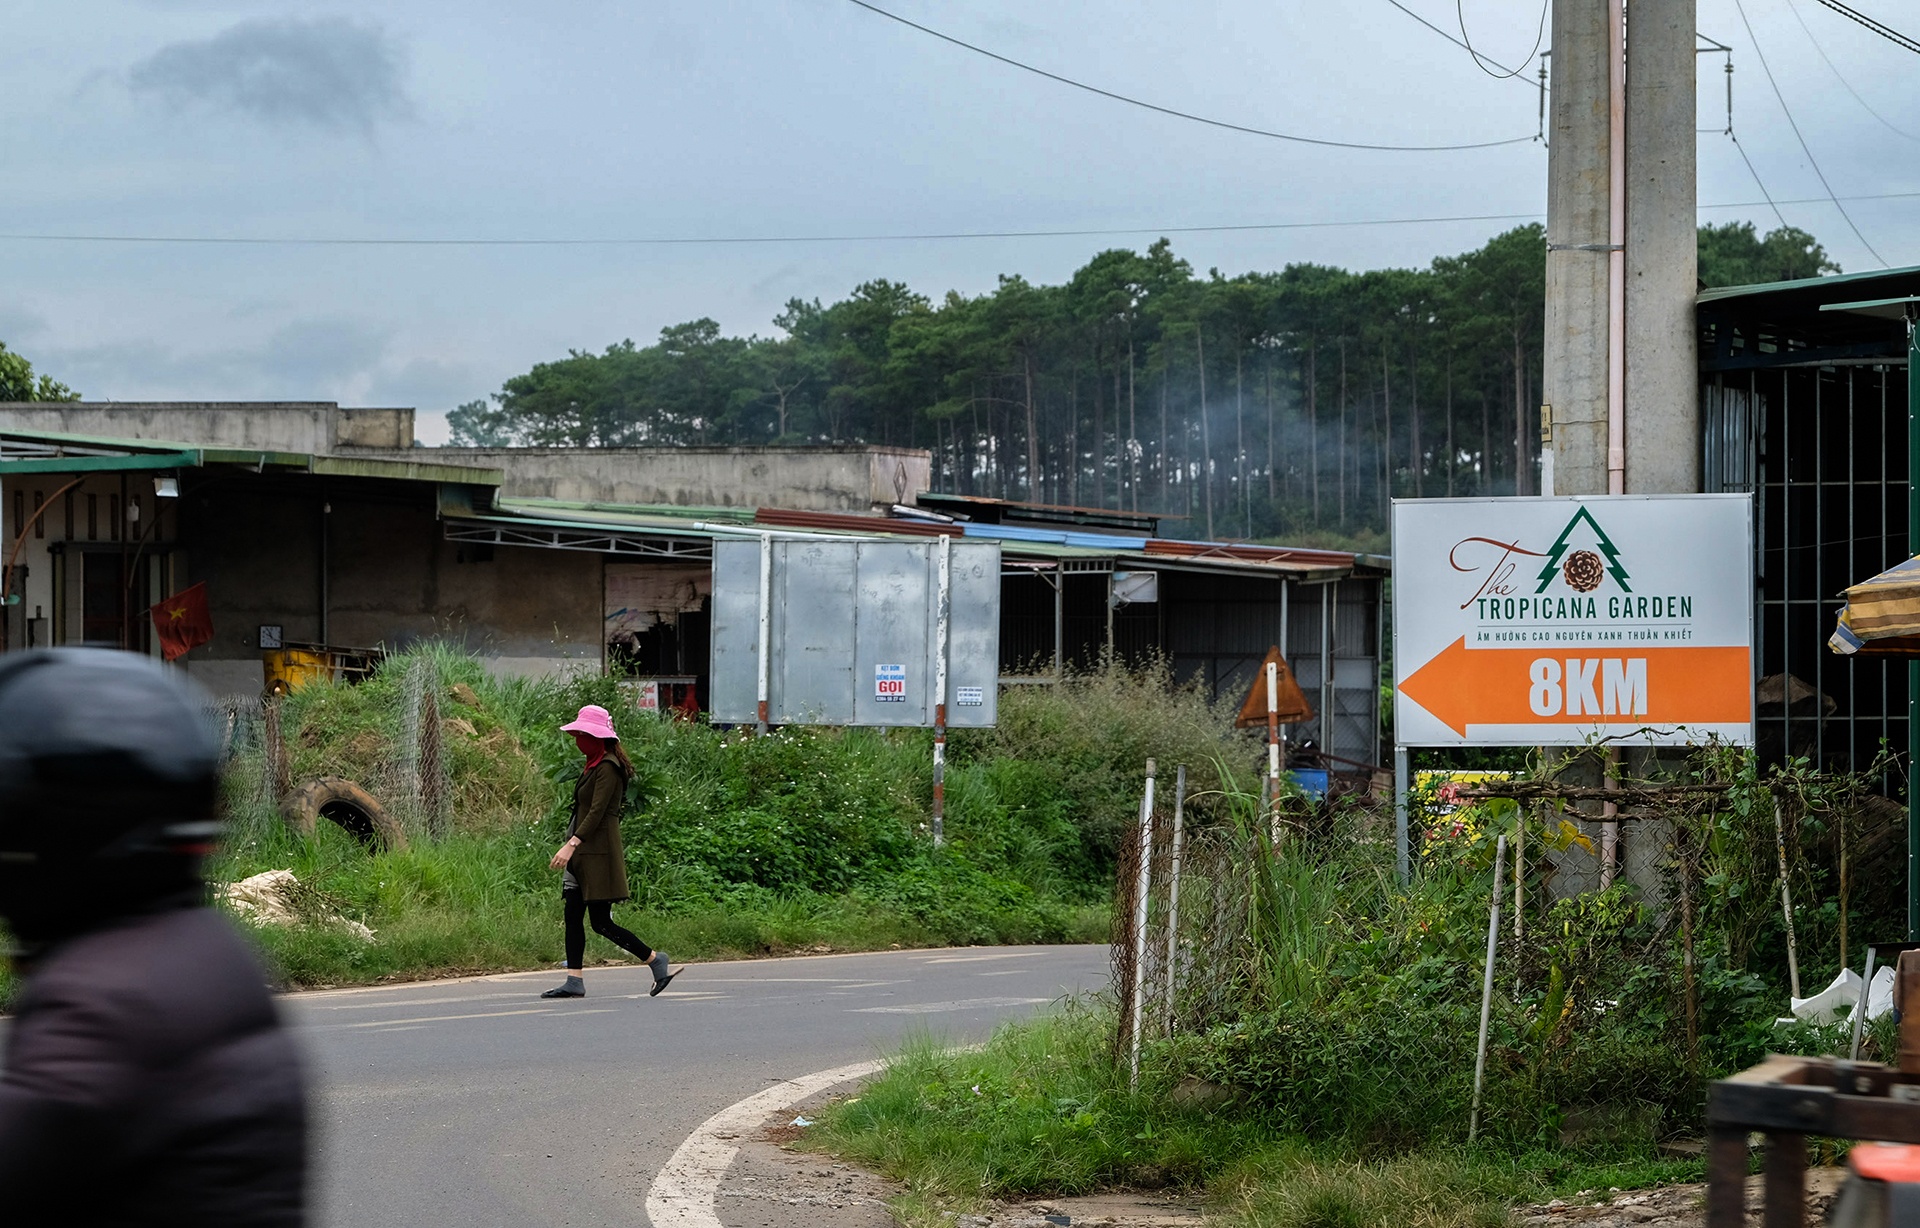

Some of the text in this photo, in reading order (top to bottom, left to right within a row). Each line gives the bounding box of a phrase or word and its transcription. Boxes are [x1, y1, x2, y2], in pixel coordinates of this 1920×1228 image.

[1449, 537, 1547, 610] The
[1477, 596, 1692, 620] TROPICANA GARDEN
[1532, 632, 1550, 641] CAO
[1555, 630, 1592, 641] NGUYÊN
[1597, 631, 1622, 641] XANH
[879, 681, 902, 695] GỌI
[1529, 658, 1647, 716] 8KM
